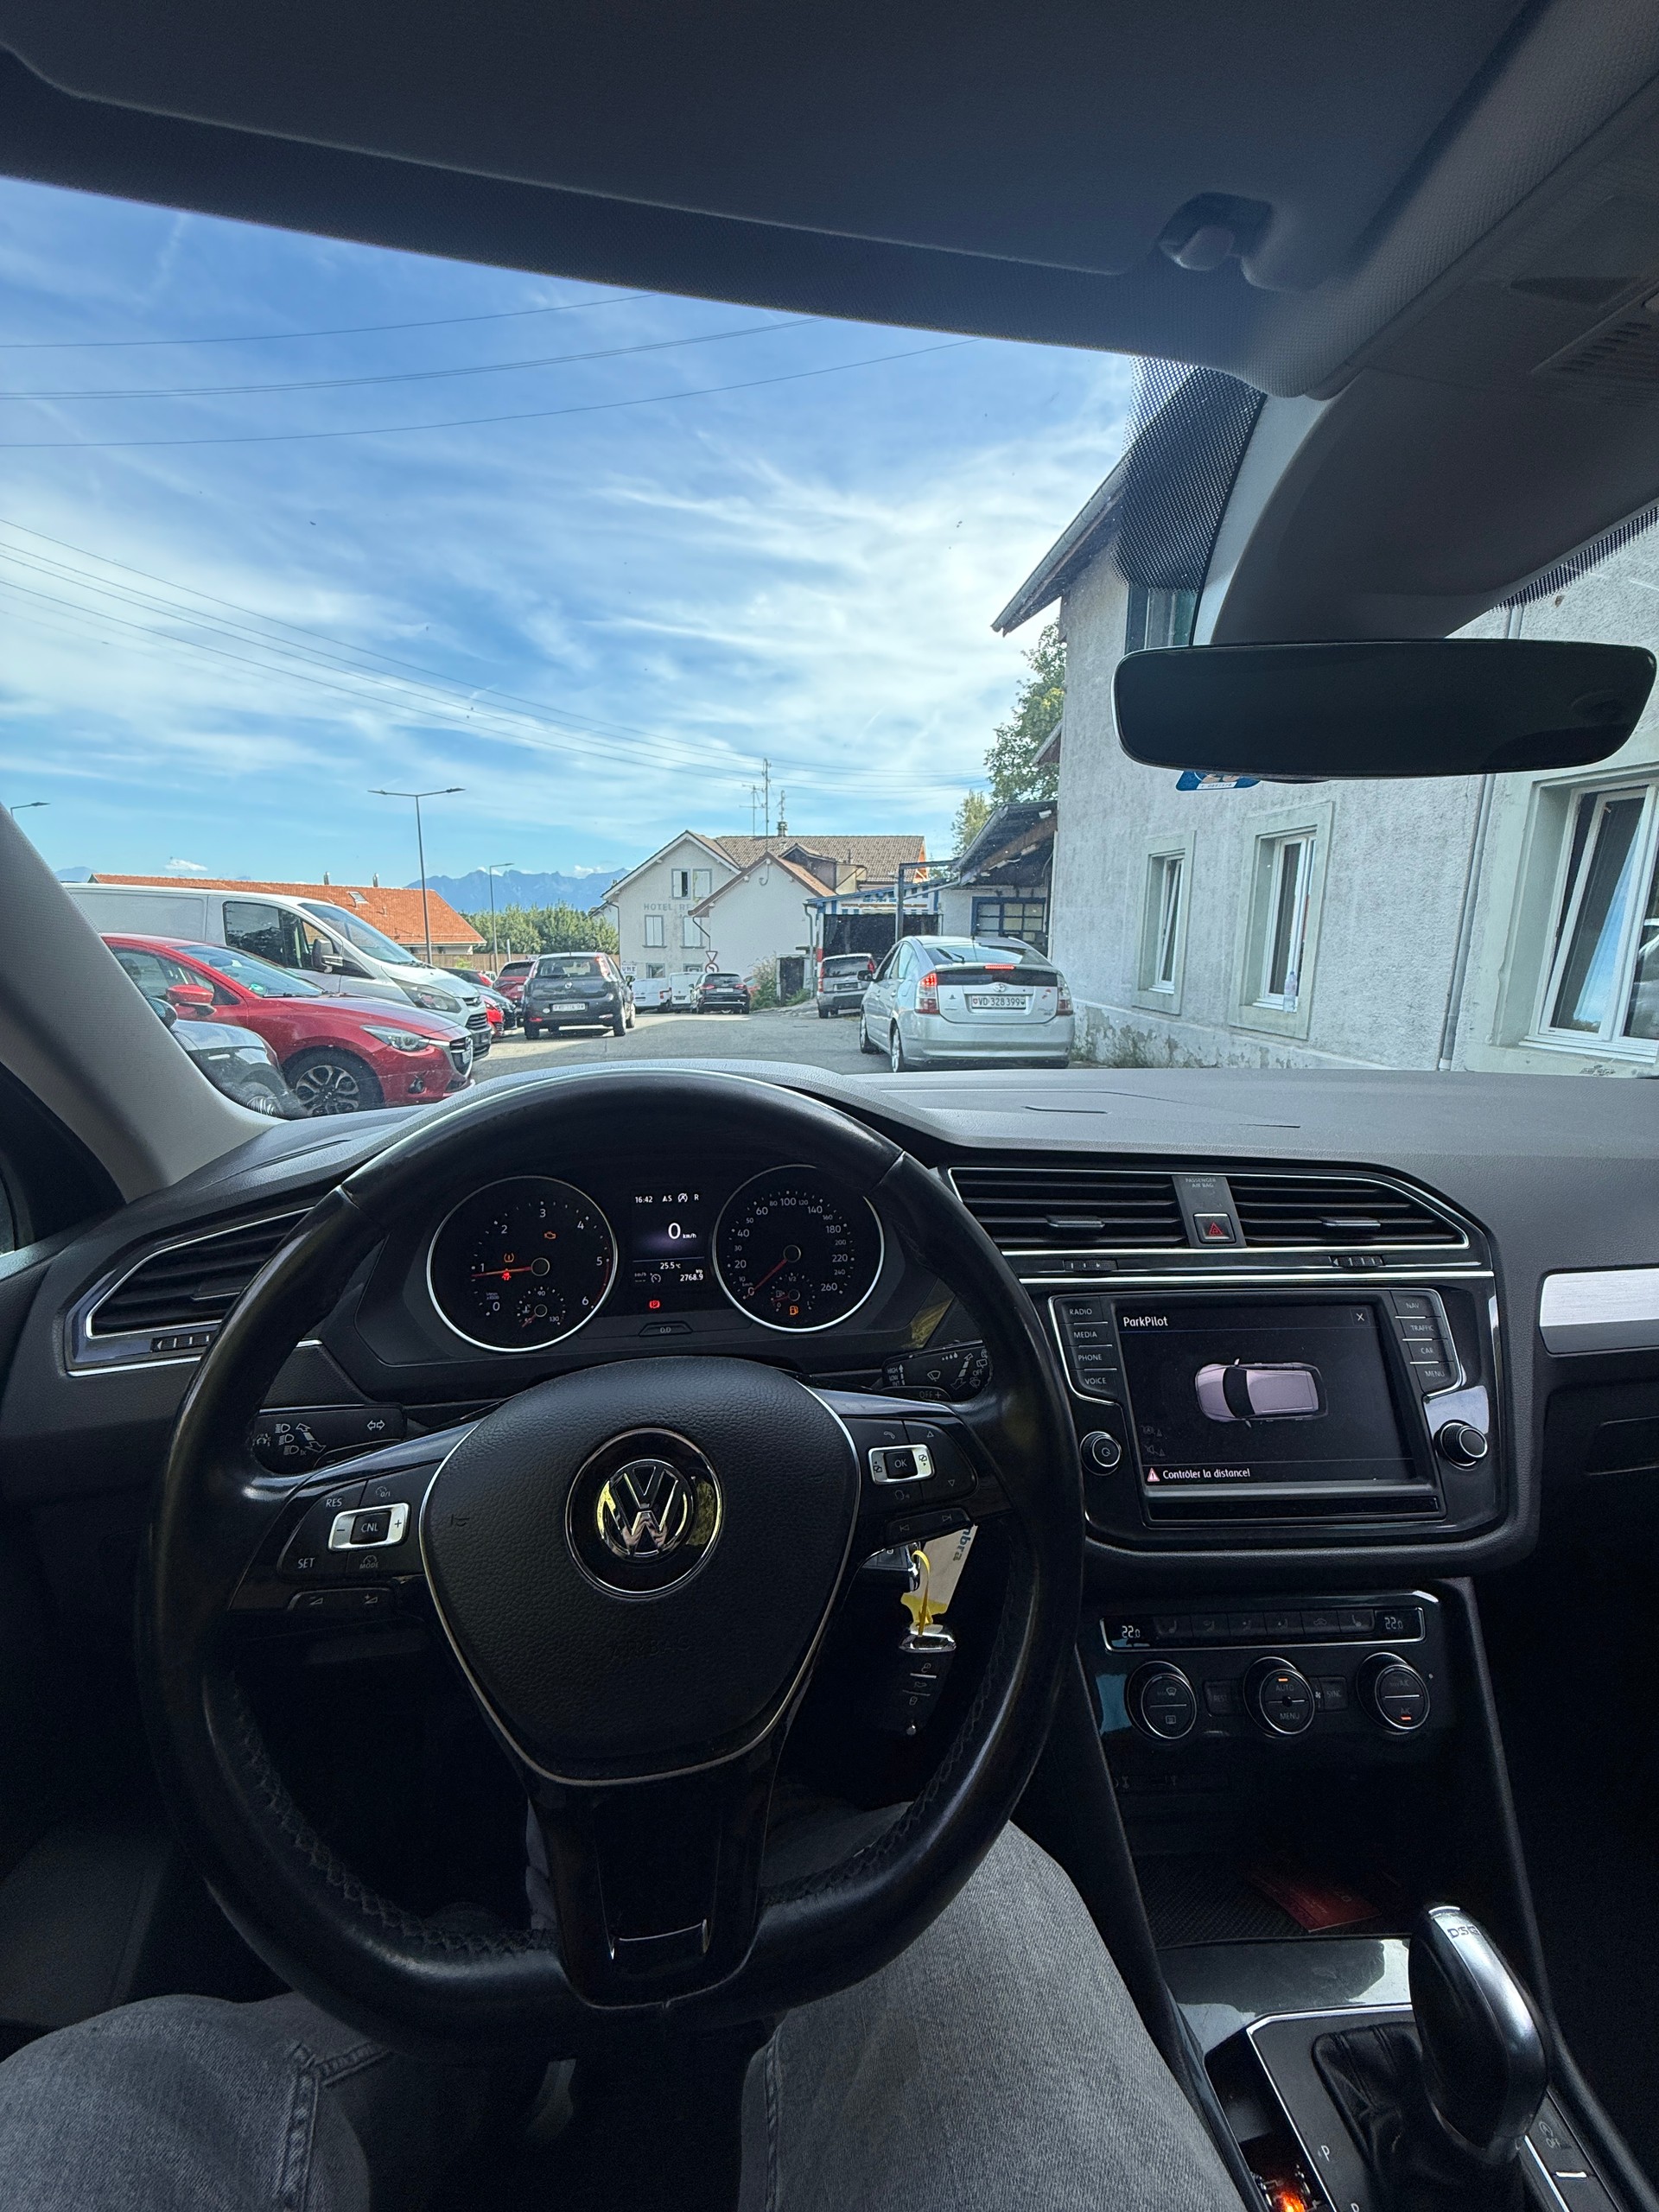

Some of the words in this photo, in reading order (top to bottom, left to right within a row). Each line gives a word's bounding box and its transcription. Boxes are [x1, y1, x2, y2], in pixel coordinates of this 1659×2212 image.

[978, 997, 988, 1006] VD
[779, 1197, 797, 1206] 100
[540, 1208, 546, 1217] 3
[755, 1206, 768, 1216] 60
[807, 1205, 823, 1215] 140
[501, 1224, 508, 1234] 2
[577, 1220, 584, 1230] 4
[825, 1224, 842, 1234] 180
[668, 1222, 681, 1240] 0
[737, 1229, 750, 1238] 40
[596, 1256, 603, 1266] 5
[831, 1253, 848, 1263] 220
[734, 1259, 747, 1268] 20
[680, 1273, 703, 1282] 2768.9
[820, 1282, 838, 1293] 260
[582, 1296, 589, 1306] 6
[493, 1302, 500, 1311] 0
[1123, 1316, 1168, 1327] ParkPilot
[1084, 1376, 1107, 1385] VOICE
[919, 1390, 933, 1399] OFF
[894, 1459, 907, 1468] OK
[1162, 1469, 1201, 1479] Contrôler
[1203, 1469, 1211, 1478] la
[326, 1497, 343, 1507] RES
[360, 1522, 378, 1533] CNL
[297, 1557, 315, 1568] SET
[359, 1560, 379, 1569] MODE
[1384, 1617, 1403, 1630] 22.0
[1122, 1624, 1141, 1638] 22.0
[1326, 1689, 1342, 1698] SYNC
[1320, 2145, 1331, 2162] P
